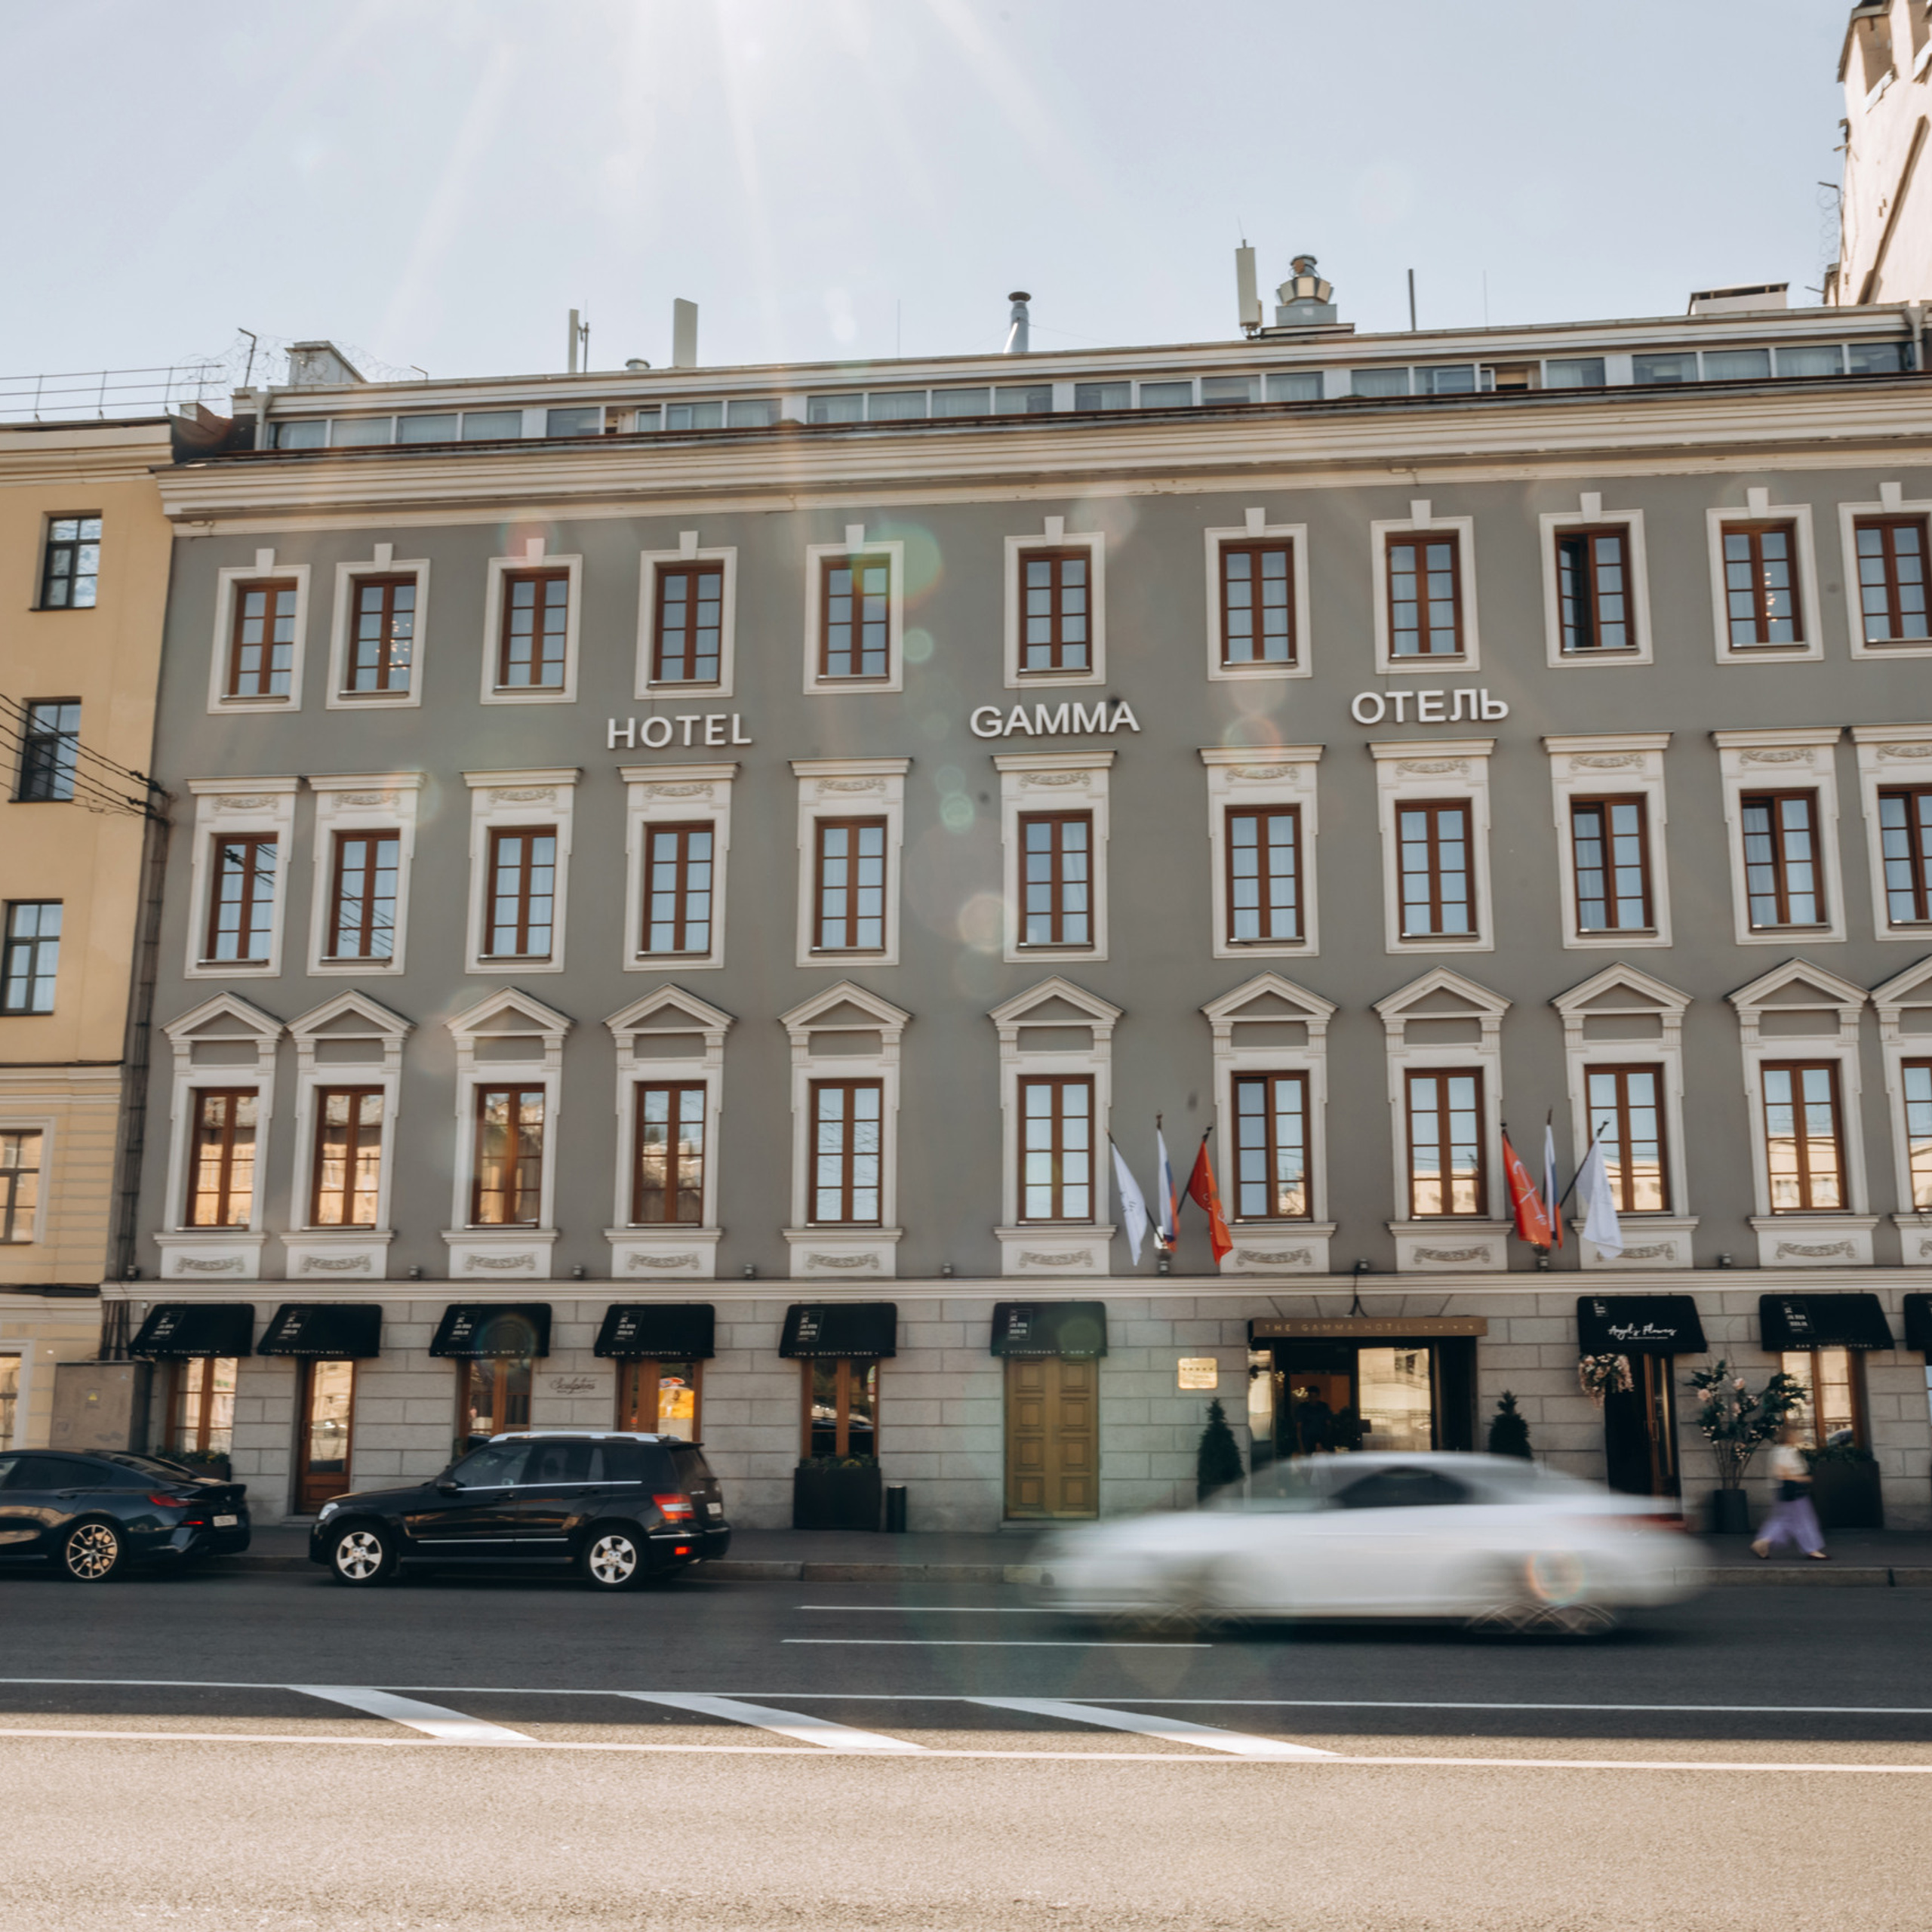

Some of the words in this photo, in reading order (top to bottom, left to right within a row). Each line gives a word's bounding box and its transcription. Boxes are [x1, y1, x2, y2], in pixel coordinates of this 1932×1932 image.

[970, 701, 1140, 739] GAMMA
[1351, 688, 1509, 724] ОТЕЛЬ
[606, 713, 753, 749] HOTEL
[1364, 1323, 1412, 1331] HOTEL
